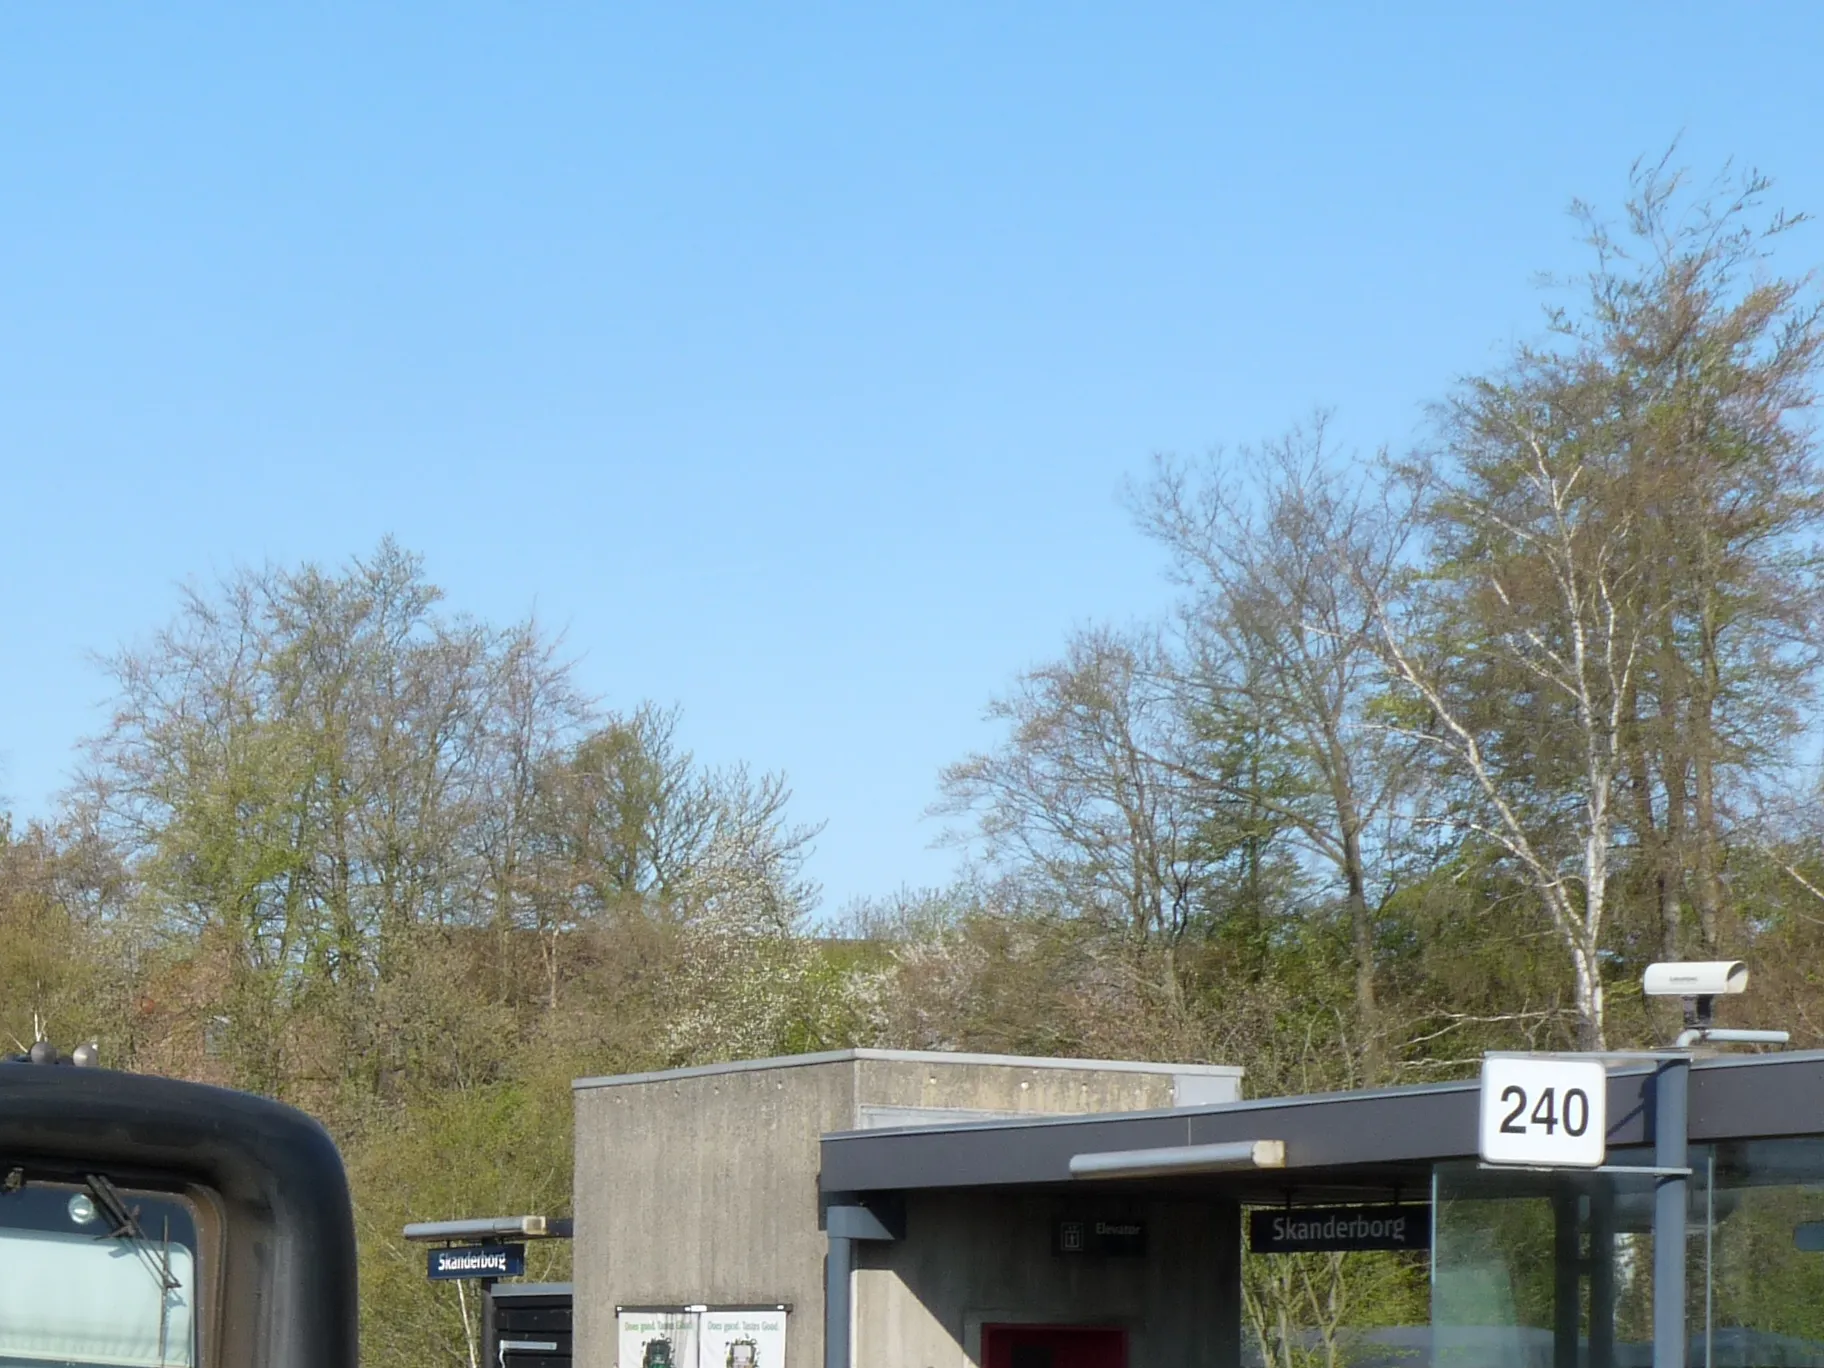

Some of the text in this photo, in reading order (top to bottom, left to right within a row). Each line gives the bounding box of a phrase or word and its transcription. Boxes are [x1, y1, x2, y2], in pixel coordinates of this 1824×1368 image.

[1499, 1085, 1589, 1137] 240
[1096, 1222, 1141, 1235] Elevator
[1272, 1210, 1406, 1242] Skanderborg
[438, 1250, 507, 1271] Skanderborg
